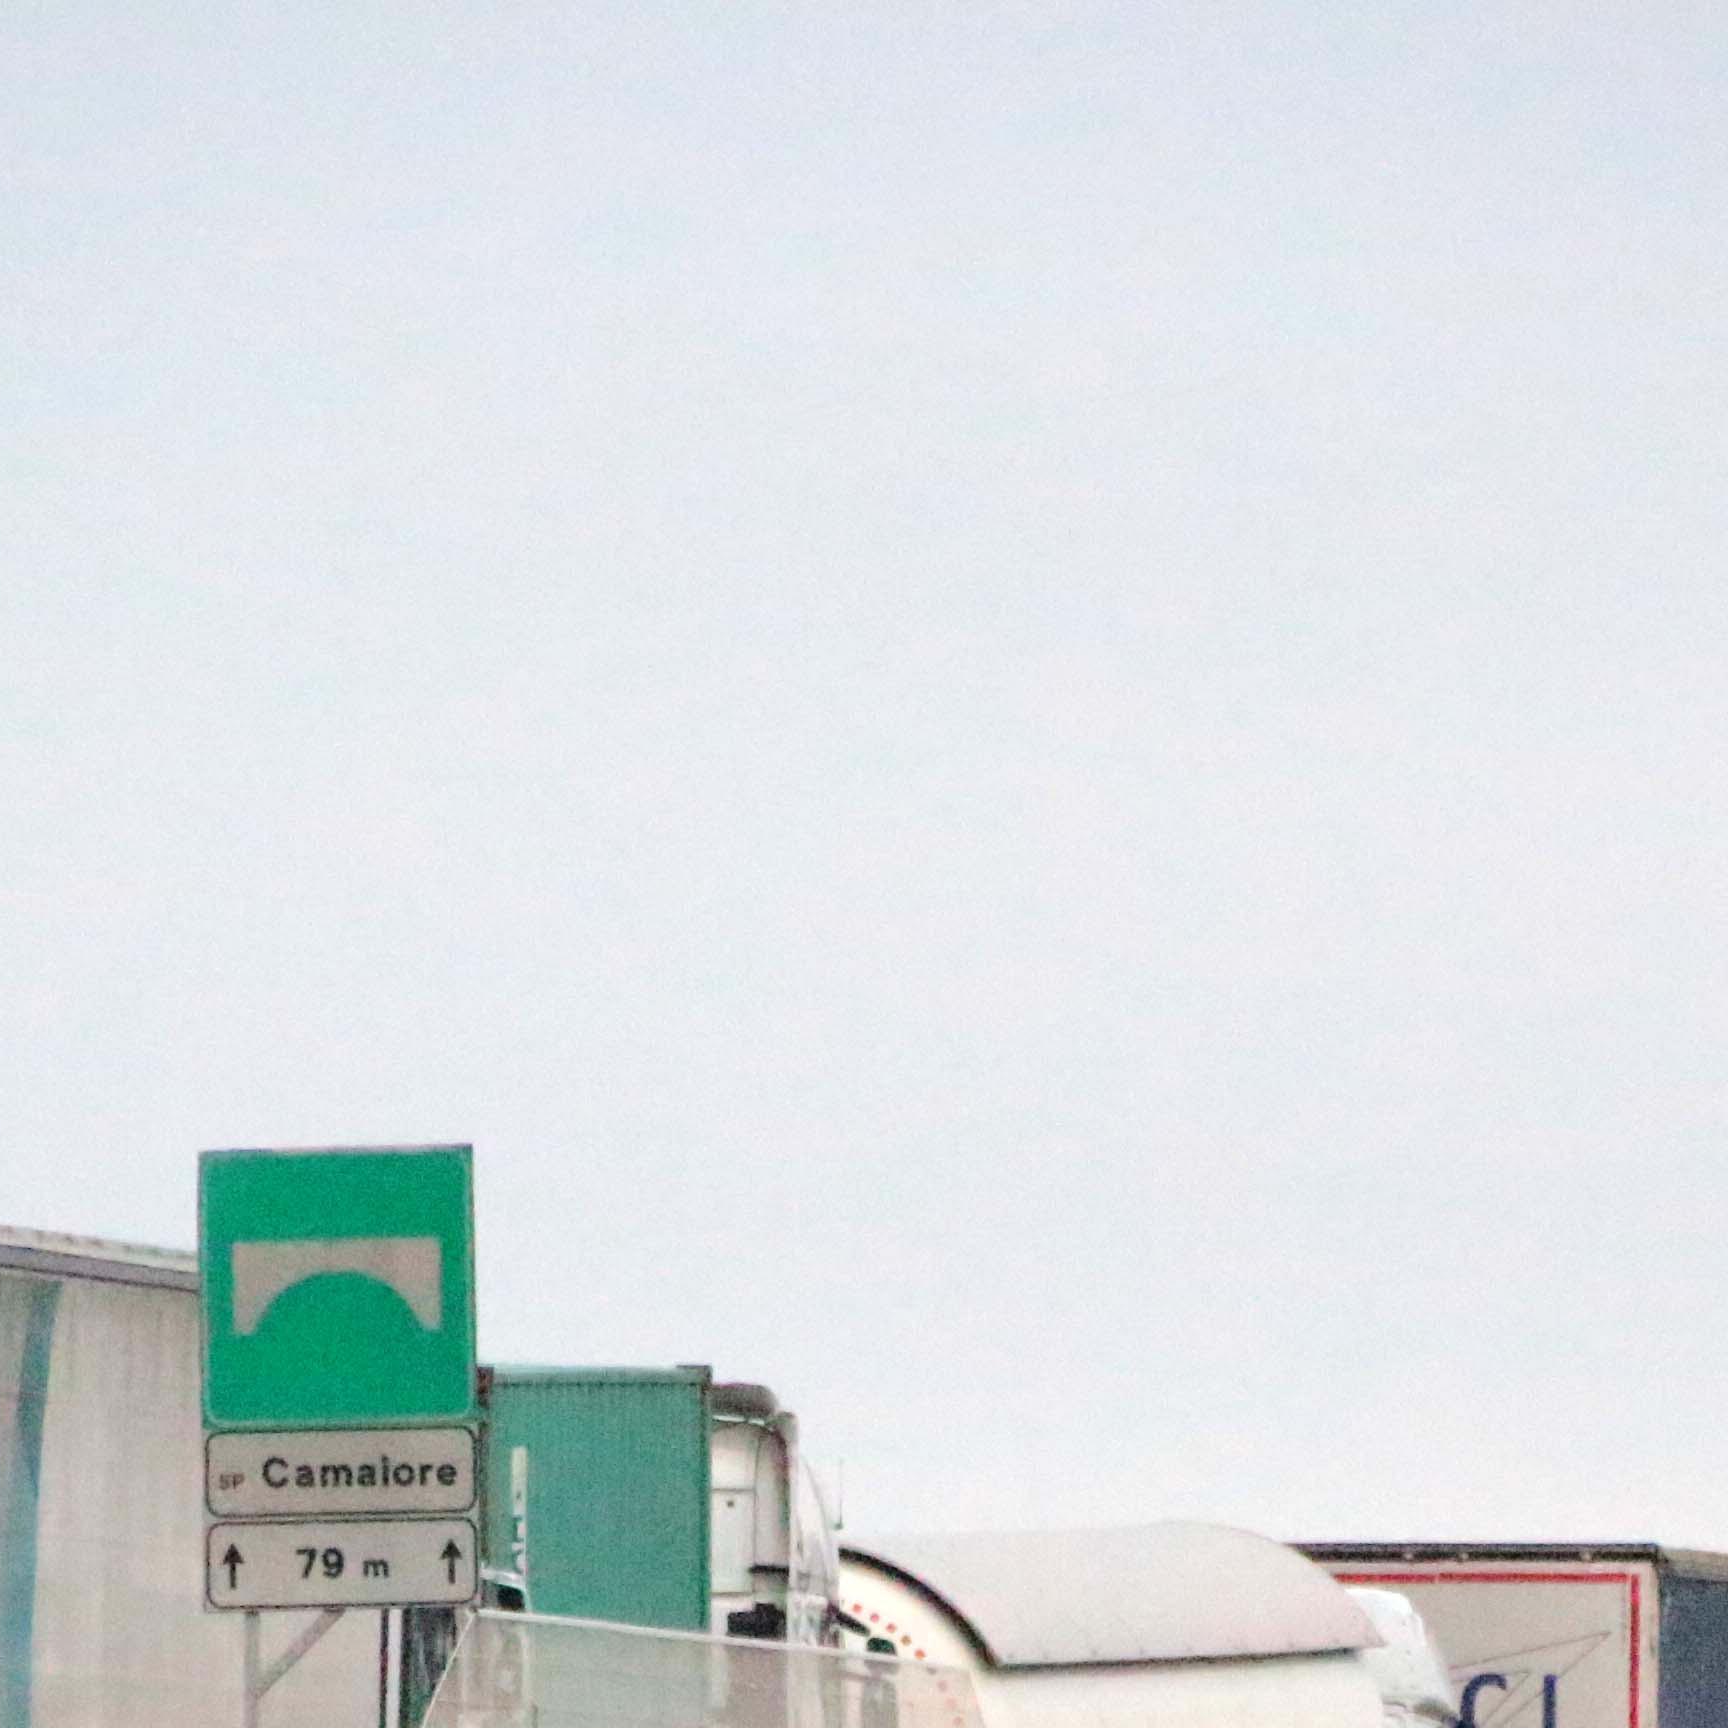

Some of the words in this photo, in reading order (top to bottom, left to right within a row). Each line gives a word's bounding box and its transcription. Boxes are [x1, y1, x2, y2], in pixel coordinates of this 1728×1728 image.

[262, 1455, 458, 1489] Camaiore
[296, 1547, 344, 1579] 79
[363, 1557, 390, 1578] m
